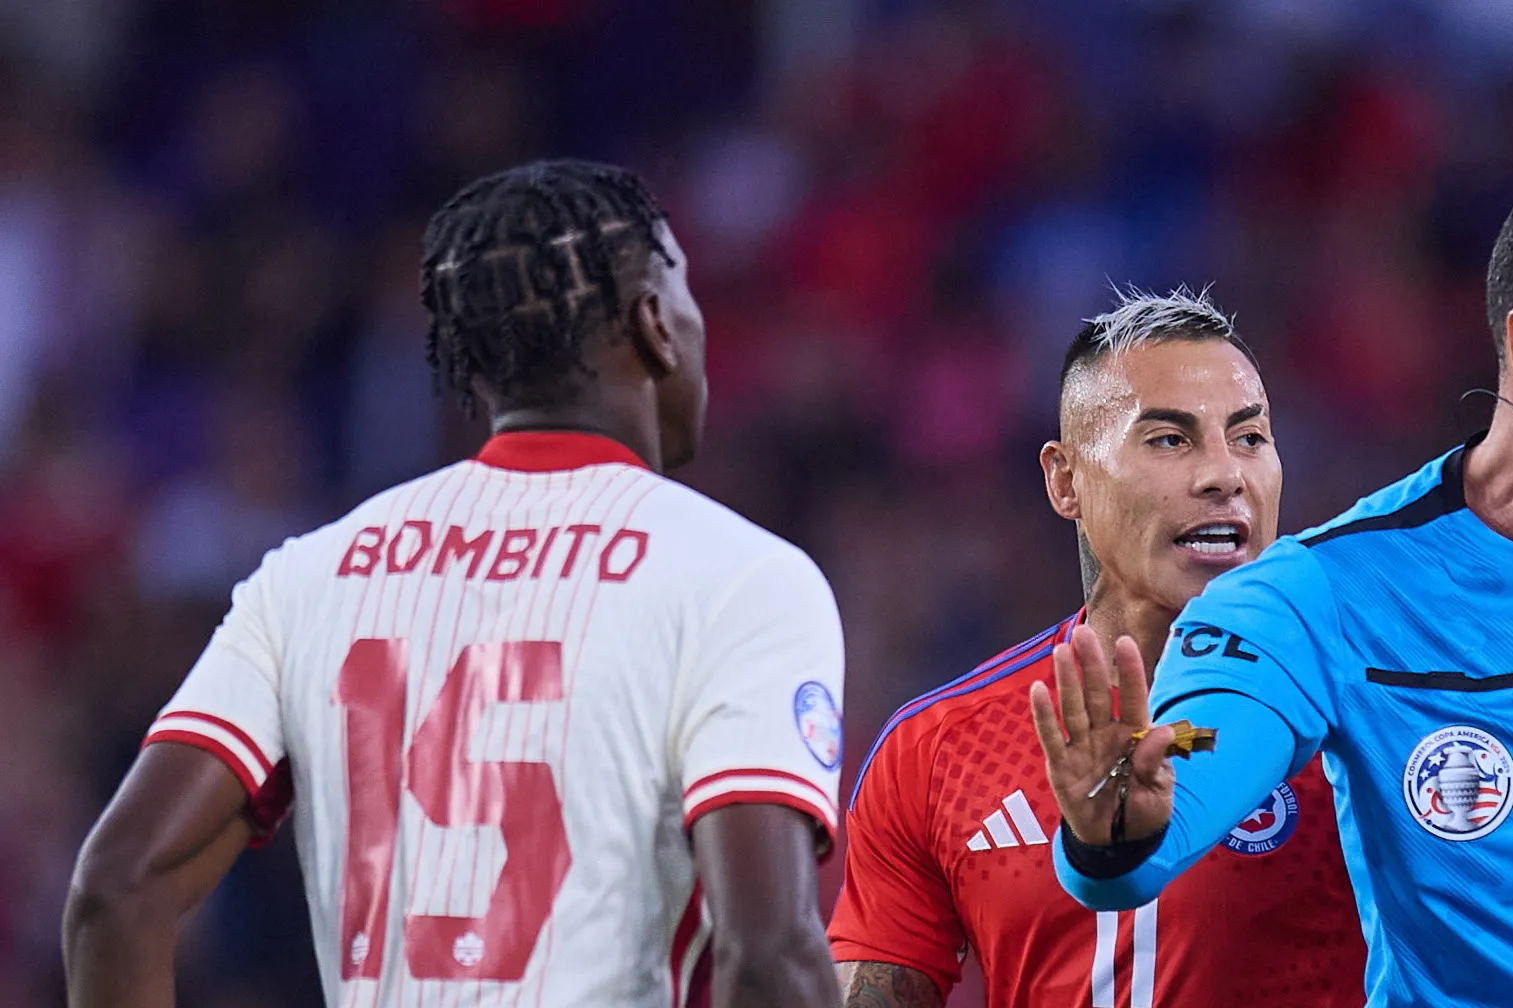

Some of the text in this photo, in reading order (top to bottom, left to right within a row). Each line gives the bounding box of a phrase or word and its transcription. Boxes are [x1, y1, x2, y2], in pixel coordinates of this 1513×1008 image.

[337, 520, 649, 583] BOMBITO
[1457, 731, 1490, 745] AMERICA
[330, 636, 573, 983] 15
[1228, 837, 1276, 853] DE CHILE
